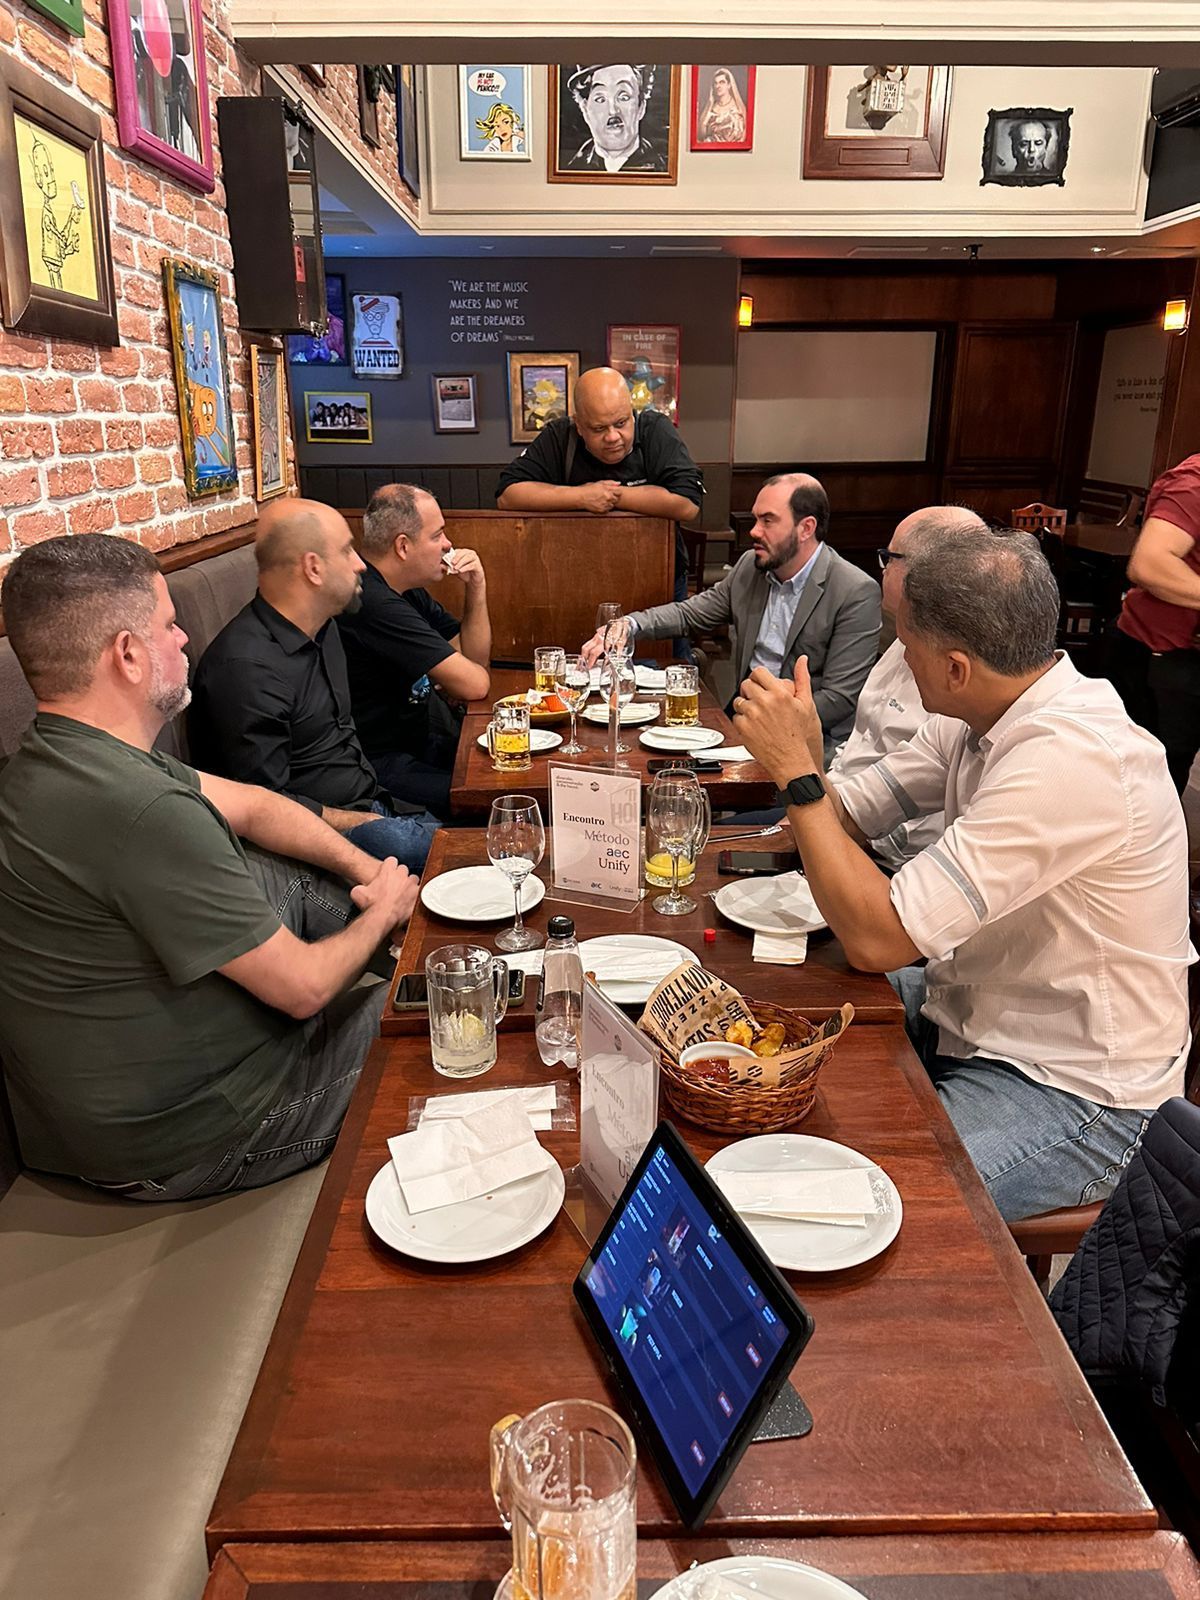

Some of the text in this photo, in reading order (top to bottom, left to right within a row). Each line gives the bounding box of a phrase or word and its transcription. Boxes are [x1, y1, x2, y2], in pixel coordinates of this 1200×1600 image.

[469, 282, 484, 292] ARE
[486, 282, 501, 292] THE
[503, 282, 528, 292] MUSIC
[449, 297, 519, 309] MAKERS AND WE
[450, 316, 525, 325] ARE THE DREAMERS
[450, 332, 465, 342] OF
[355, 349, 400, 367] WANTED
[563, 813, 605, 826] Encontro
[584, 829, 630, 846] Método
[606, 848, 630, 859] aec
[598, 858, 630, 875] Unify
